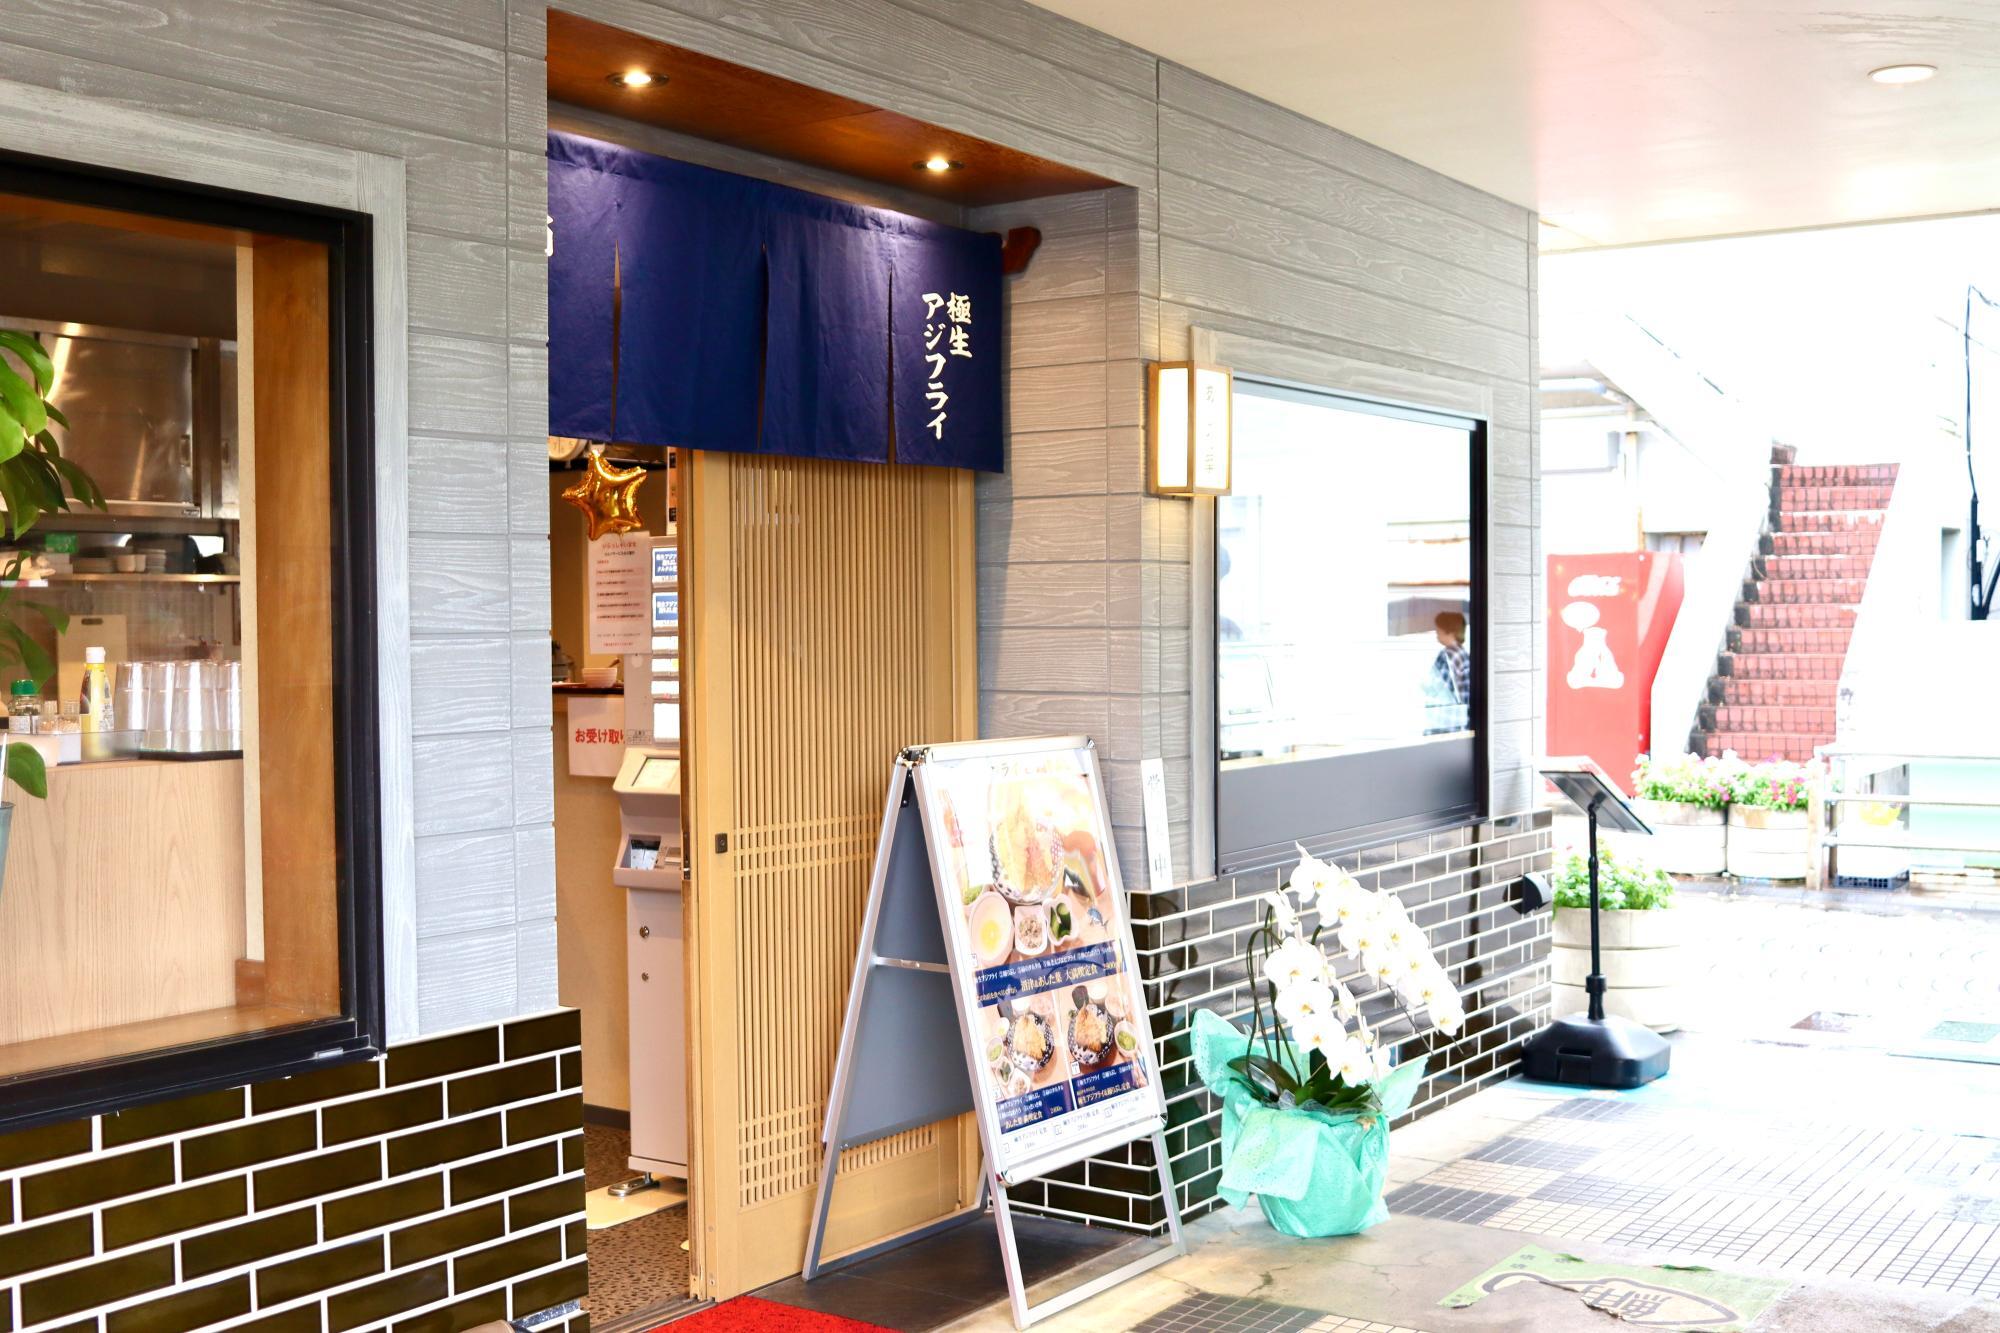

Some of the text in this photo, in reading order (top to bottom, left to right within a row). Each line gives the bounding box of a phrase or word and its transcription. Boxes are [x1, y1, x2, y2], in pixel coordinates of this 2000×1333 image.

[921, 292, 949, 440] アジフライ
[946, 291, 973, 358] 極生
